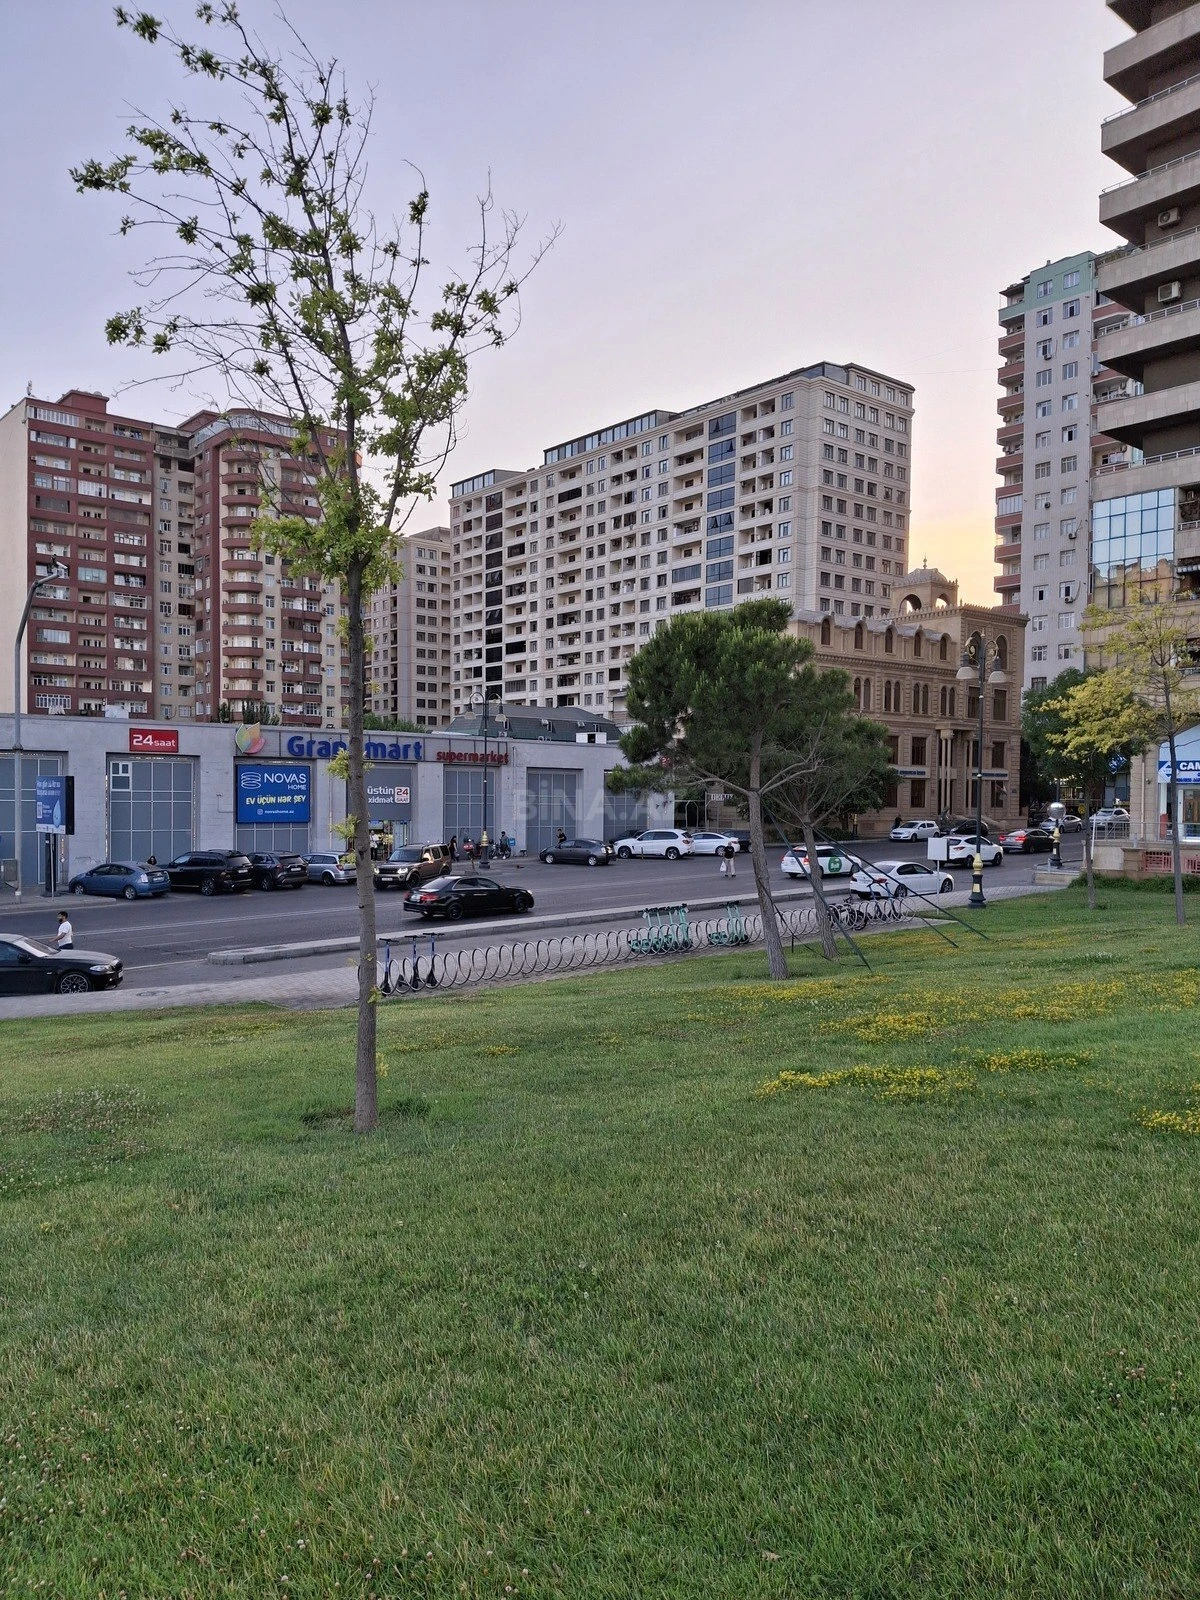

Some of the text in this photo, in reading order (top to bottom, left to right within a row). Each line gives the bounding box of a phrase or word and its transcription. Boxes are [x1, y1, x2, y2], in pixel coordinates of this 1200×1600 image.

[287, 735, 422, 761] Granmart
[436, 750, 509, 764] supermarket
[264, 773, 306, 783] NOVAS
[396, 788, 408, 796] 24
